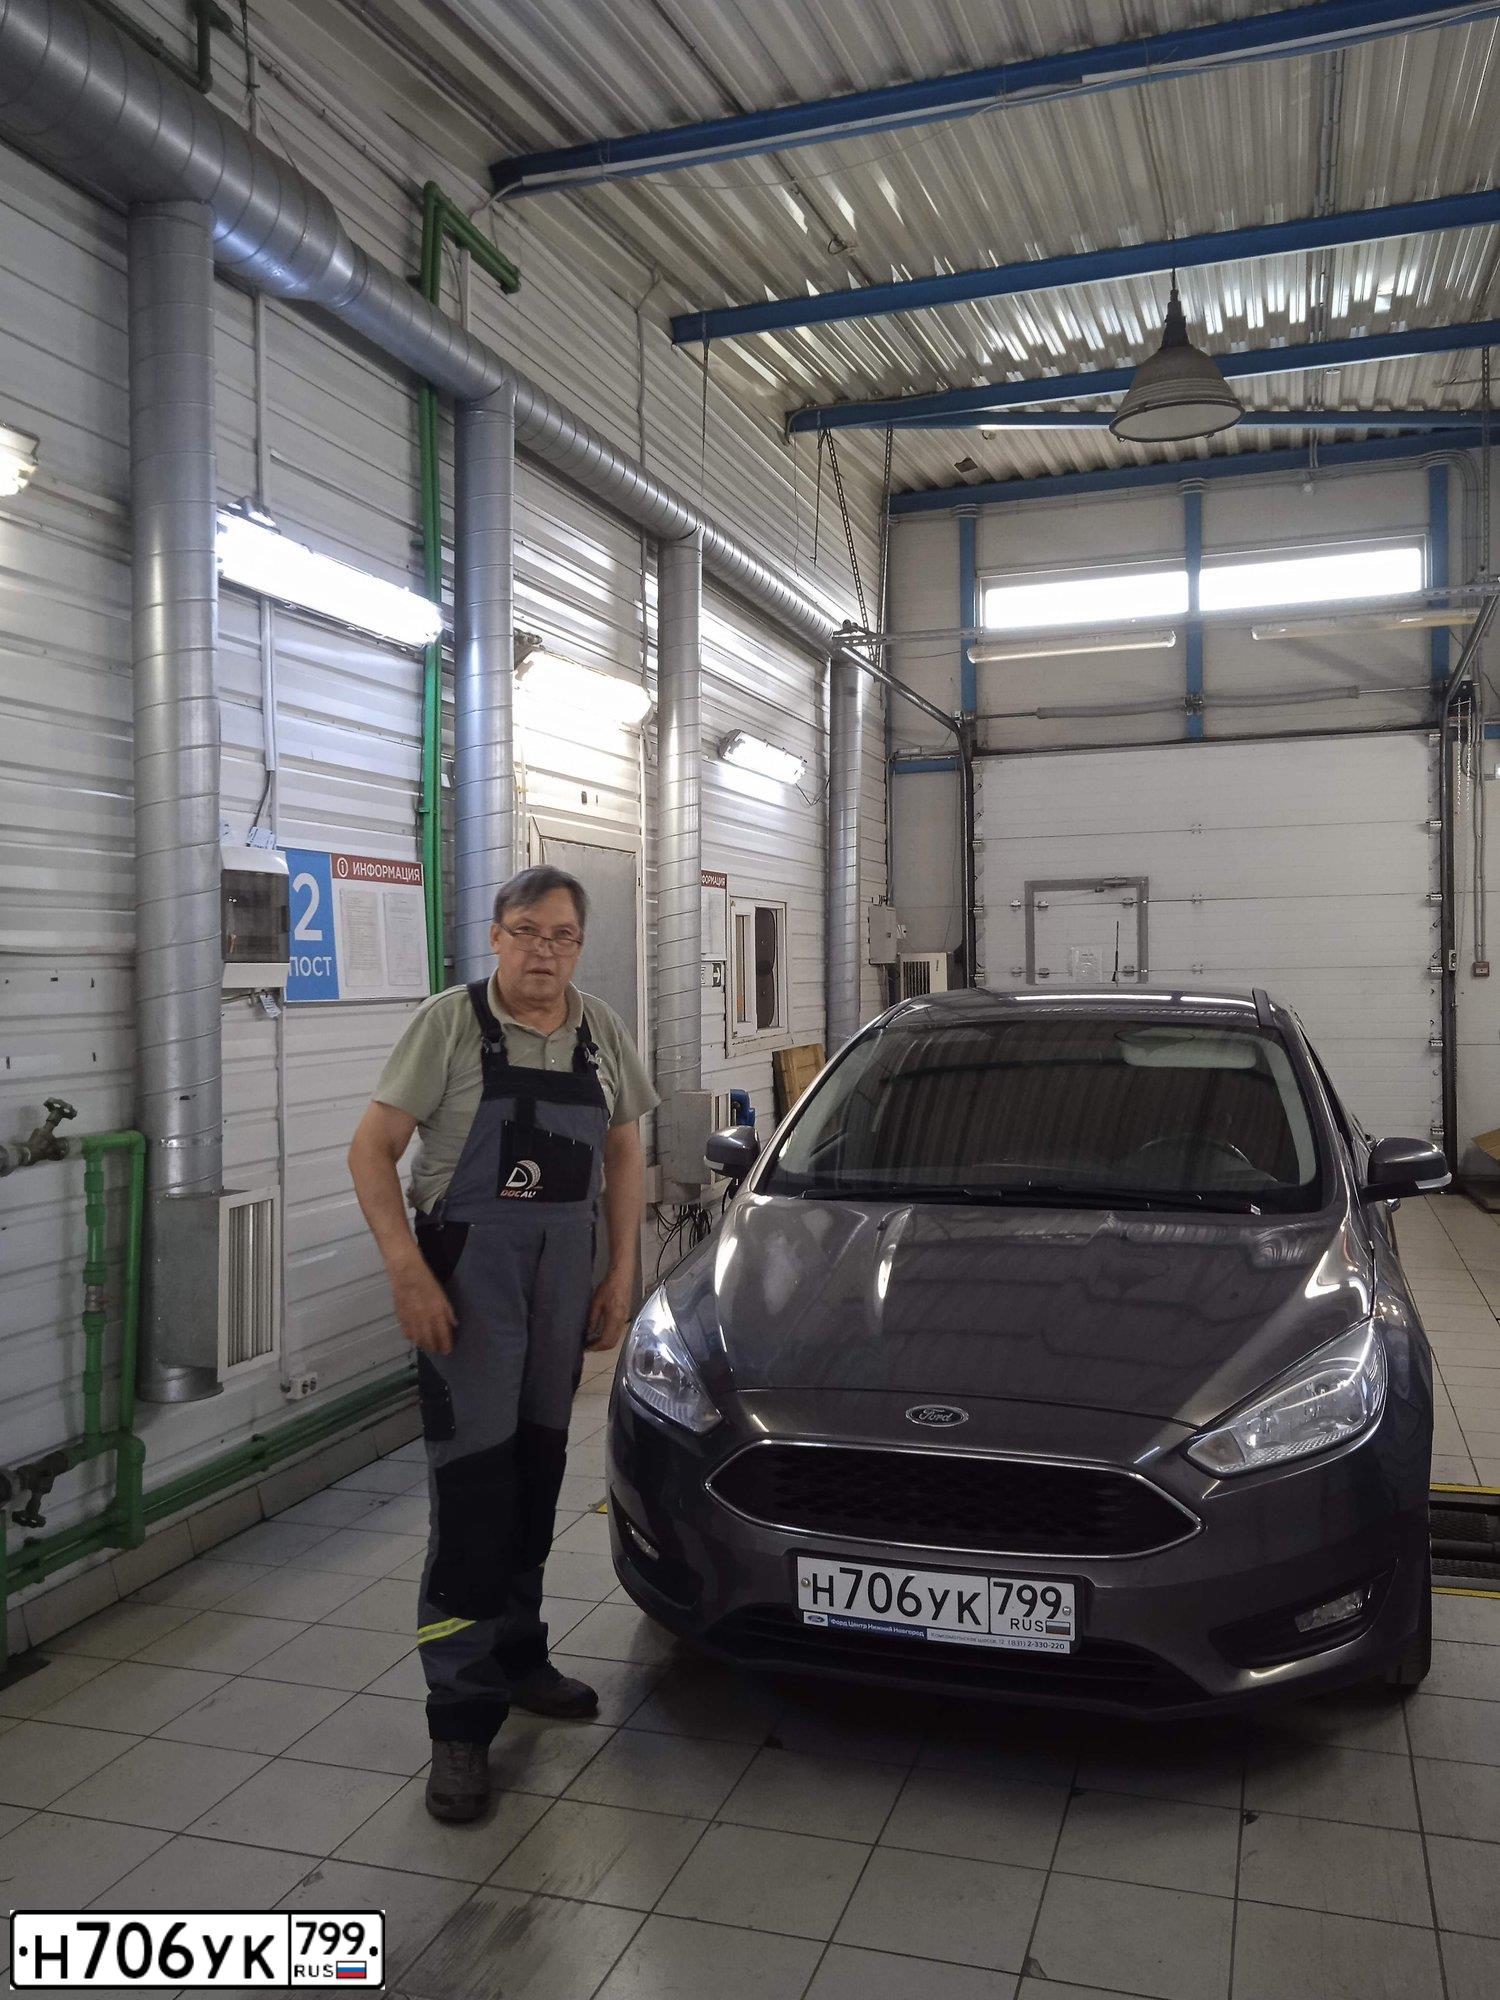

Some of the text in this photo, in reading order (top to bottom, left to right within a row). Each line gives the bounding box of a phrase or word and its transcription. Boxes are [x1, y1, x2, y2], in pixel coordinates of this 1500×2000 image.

[352, 862, 421, 882] ИНФОРМАЦИЯ
[292, 872, 323, 941] 2
[289, 956, 332, 977] ПОСТ
[918, 1408, 954, 1422] Ford
[993, 1581, 1062, 1620] 799
[1010, 1618, 1044, 1633] RUS
[1027, 1640, 1066, 1651] 2-330-220
